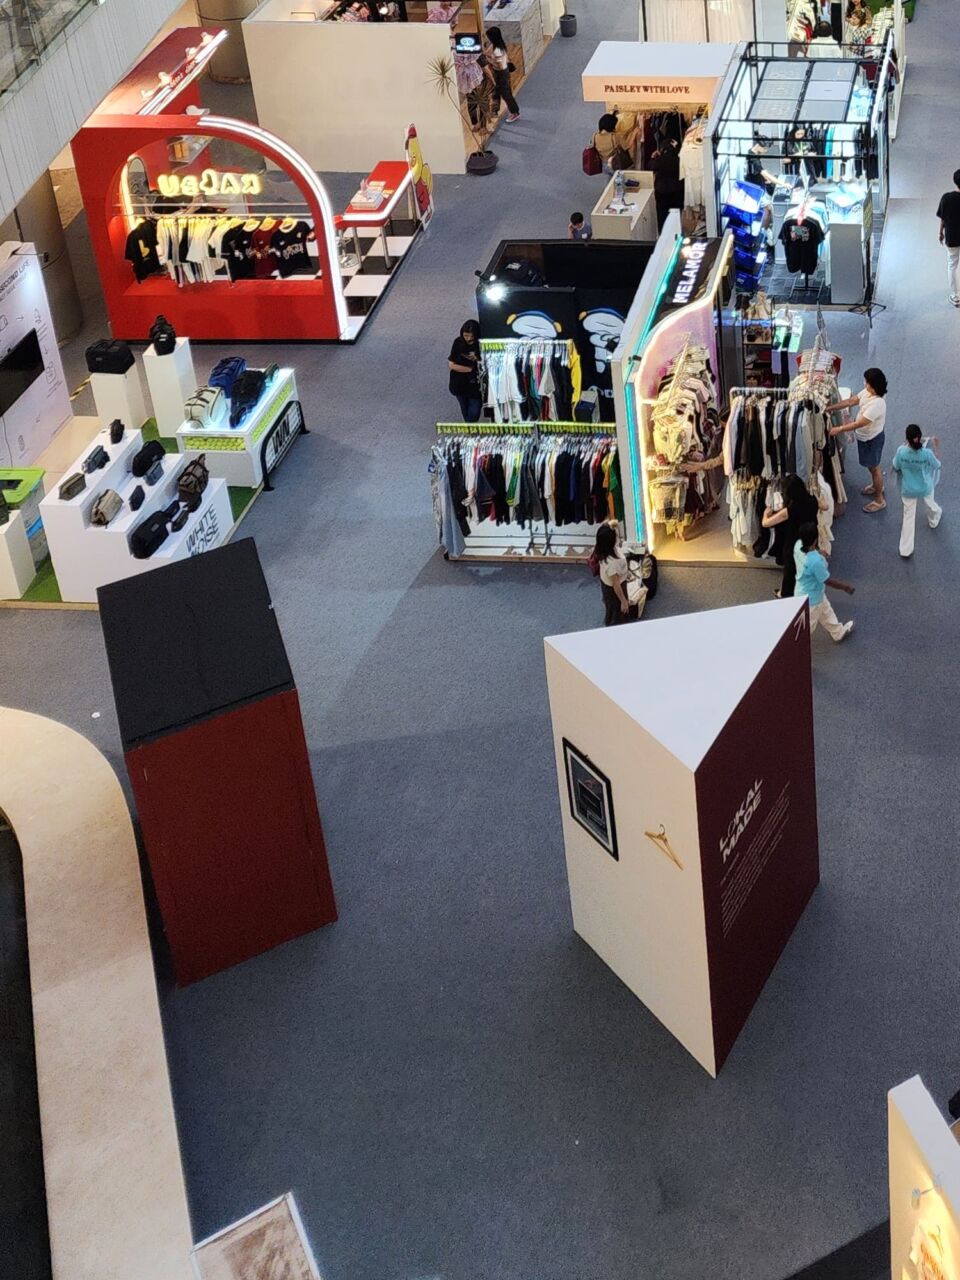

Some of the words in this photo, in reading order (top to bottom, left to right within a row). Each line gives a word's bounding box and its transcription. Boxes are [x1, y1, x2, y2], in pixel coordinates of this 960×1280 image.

[604, 84, 641, 93] PAISLEY
[642, 85, 666, 94] WITH
[667, 86, 690, 94] LOVE
[186, 503, 216, 553] WHITE
[191, 522, 220, 557] NOISE
[719, 778, 763, 852] LOKAL
[723, 790, 762, 865] MADE
